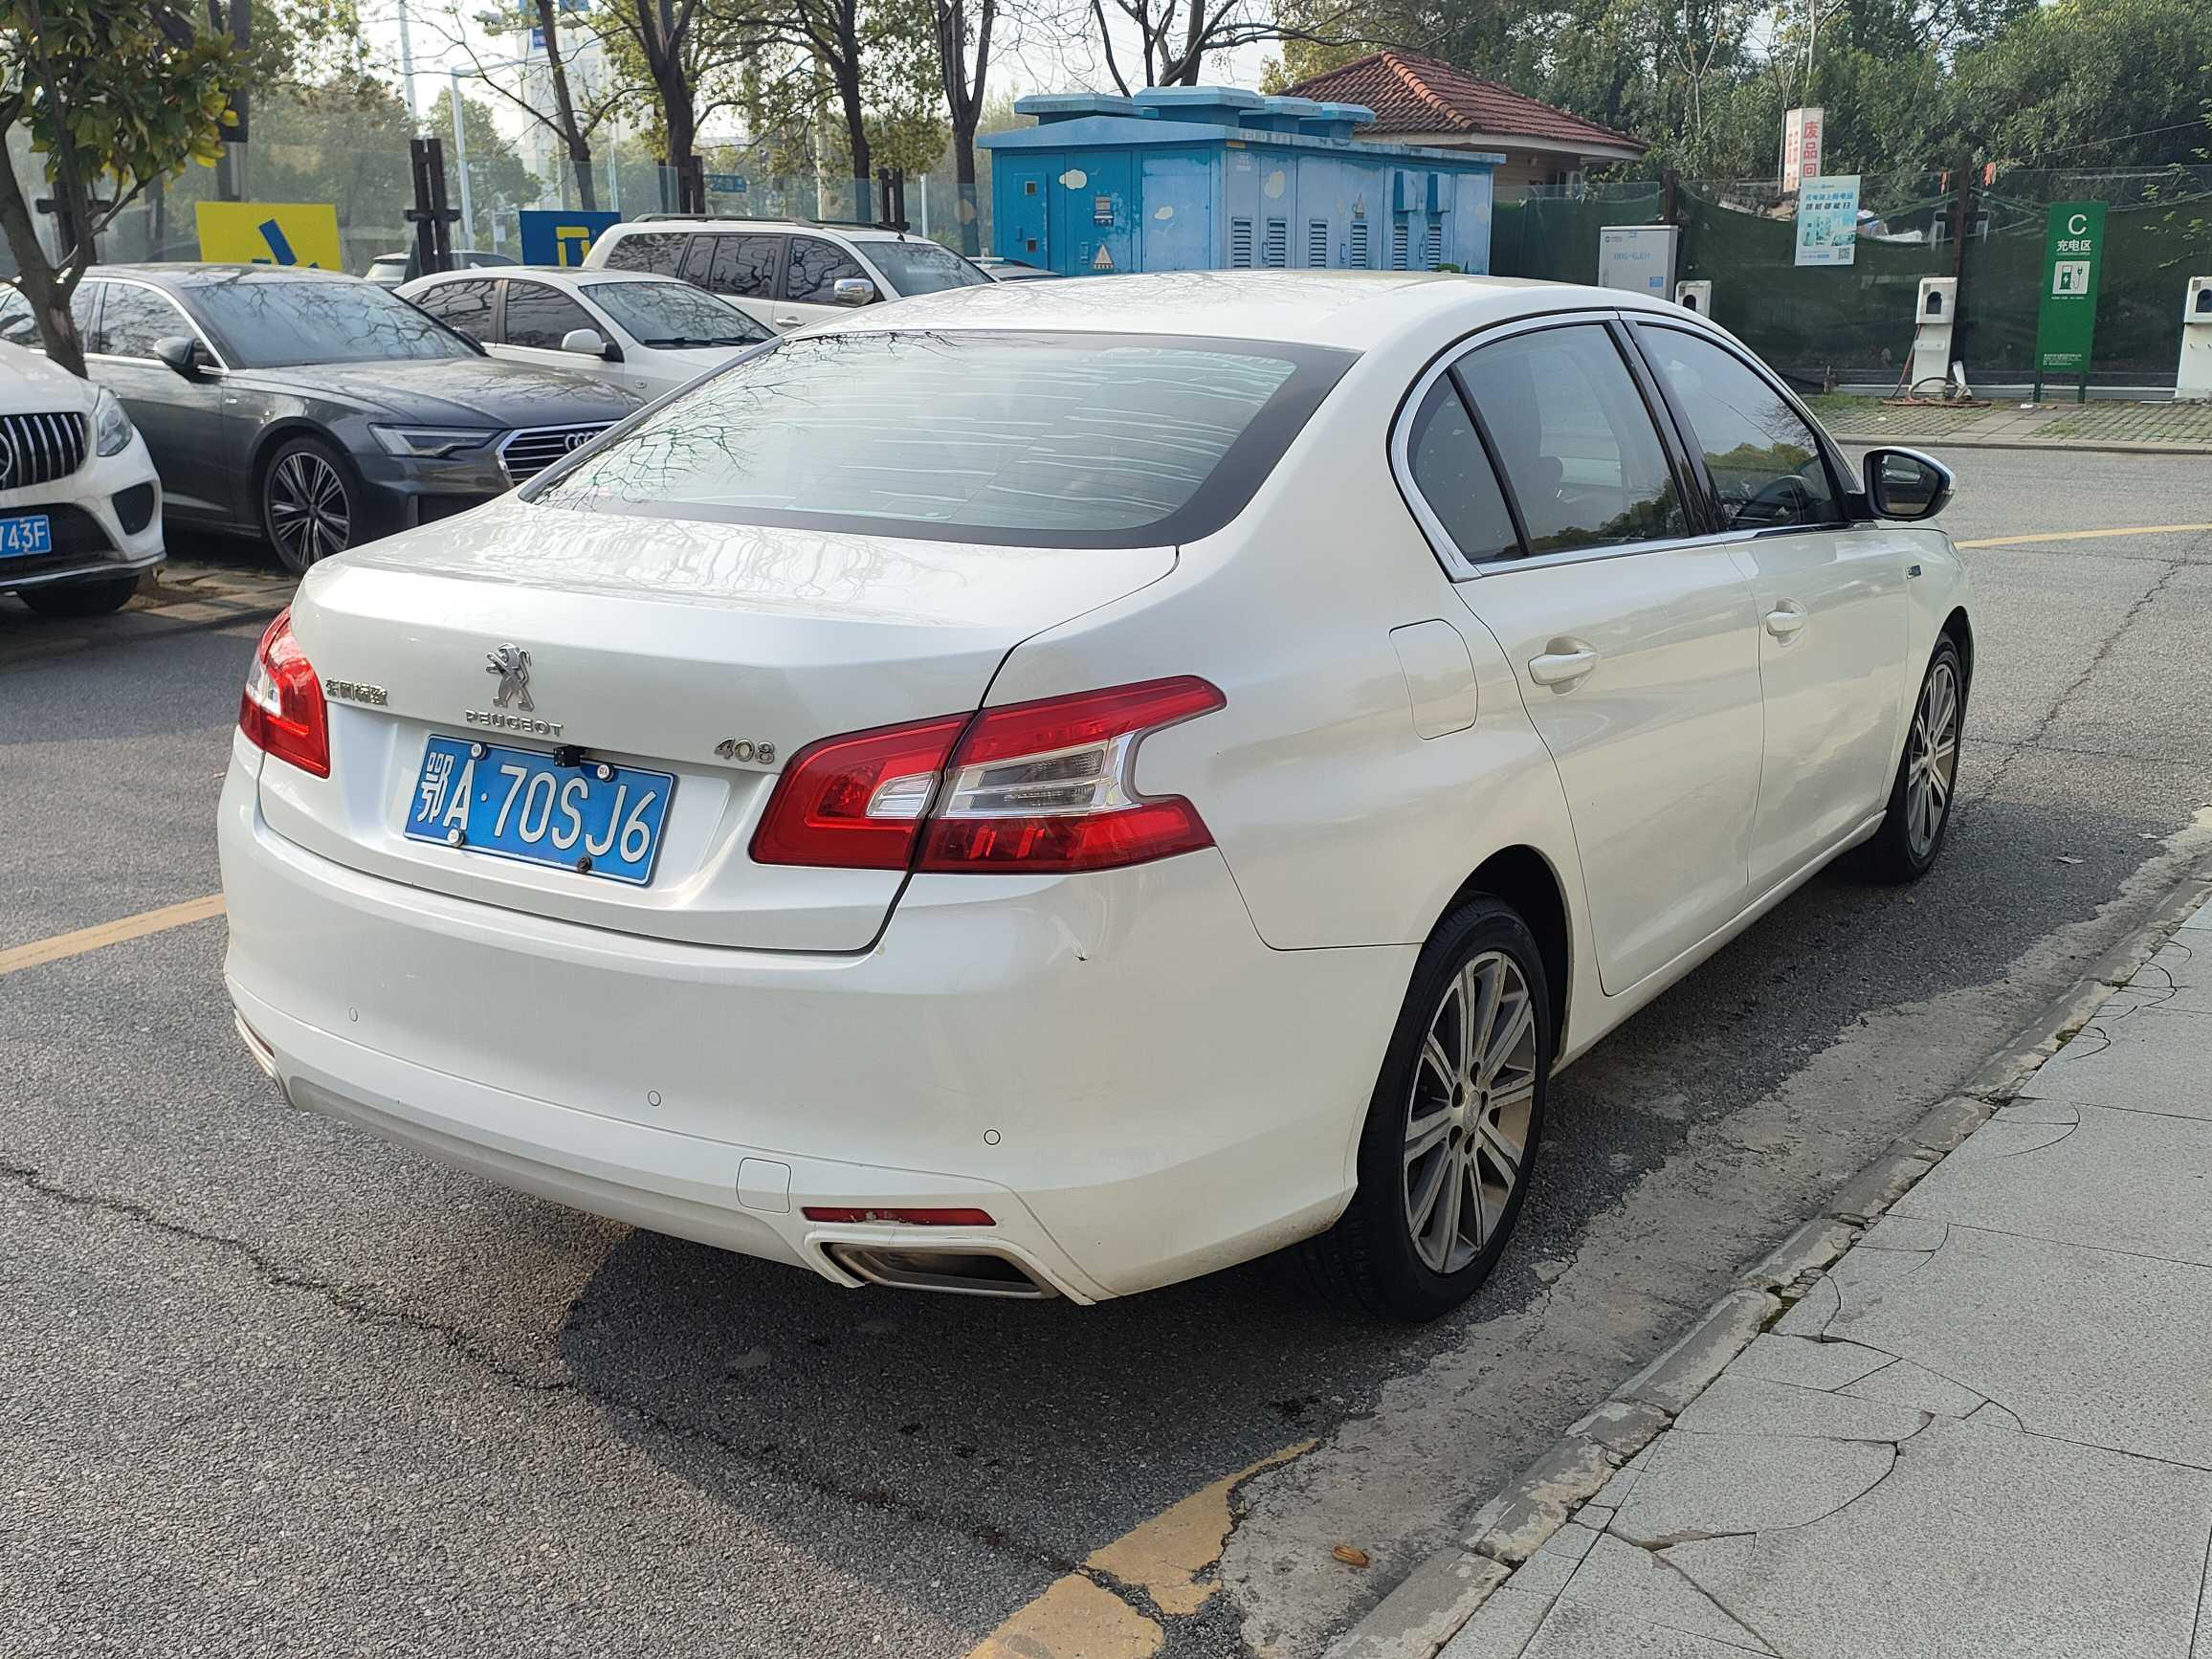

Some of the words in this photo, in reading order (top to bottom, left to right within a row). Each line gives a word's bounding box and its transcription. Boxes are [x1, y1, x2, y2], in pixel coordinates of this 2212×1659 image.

[2068, 213, 2088, 235] C
[2056, 238, 2091, 252] 充电区
[465, 709, 564, 738] PEUGEOT
[714, 737, 775, 764] 408
